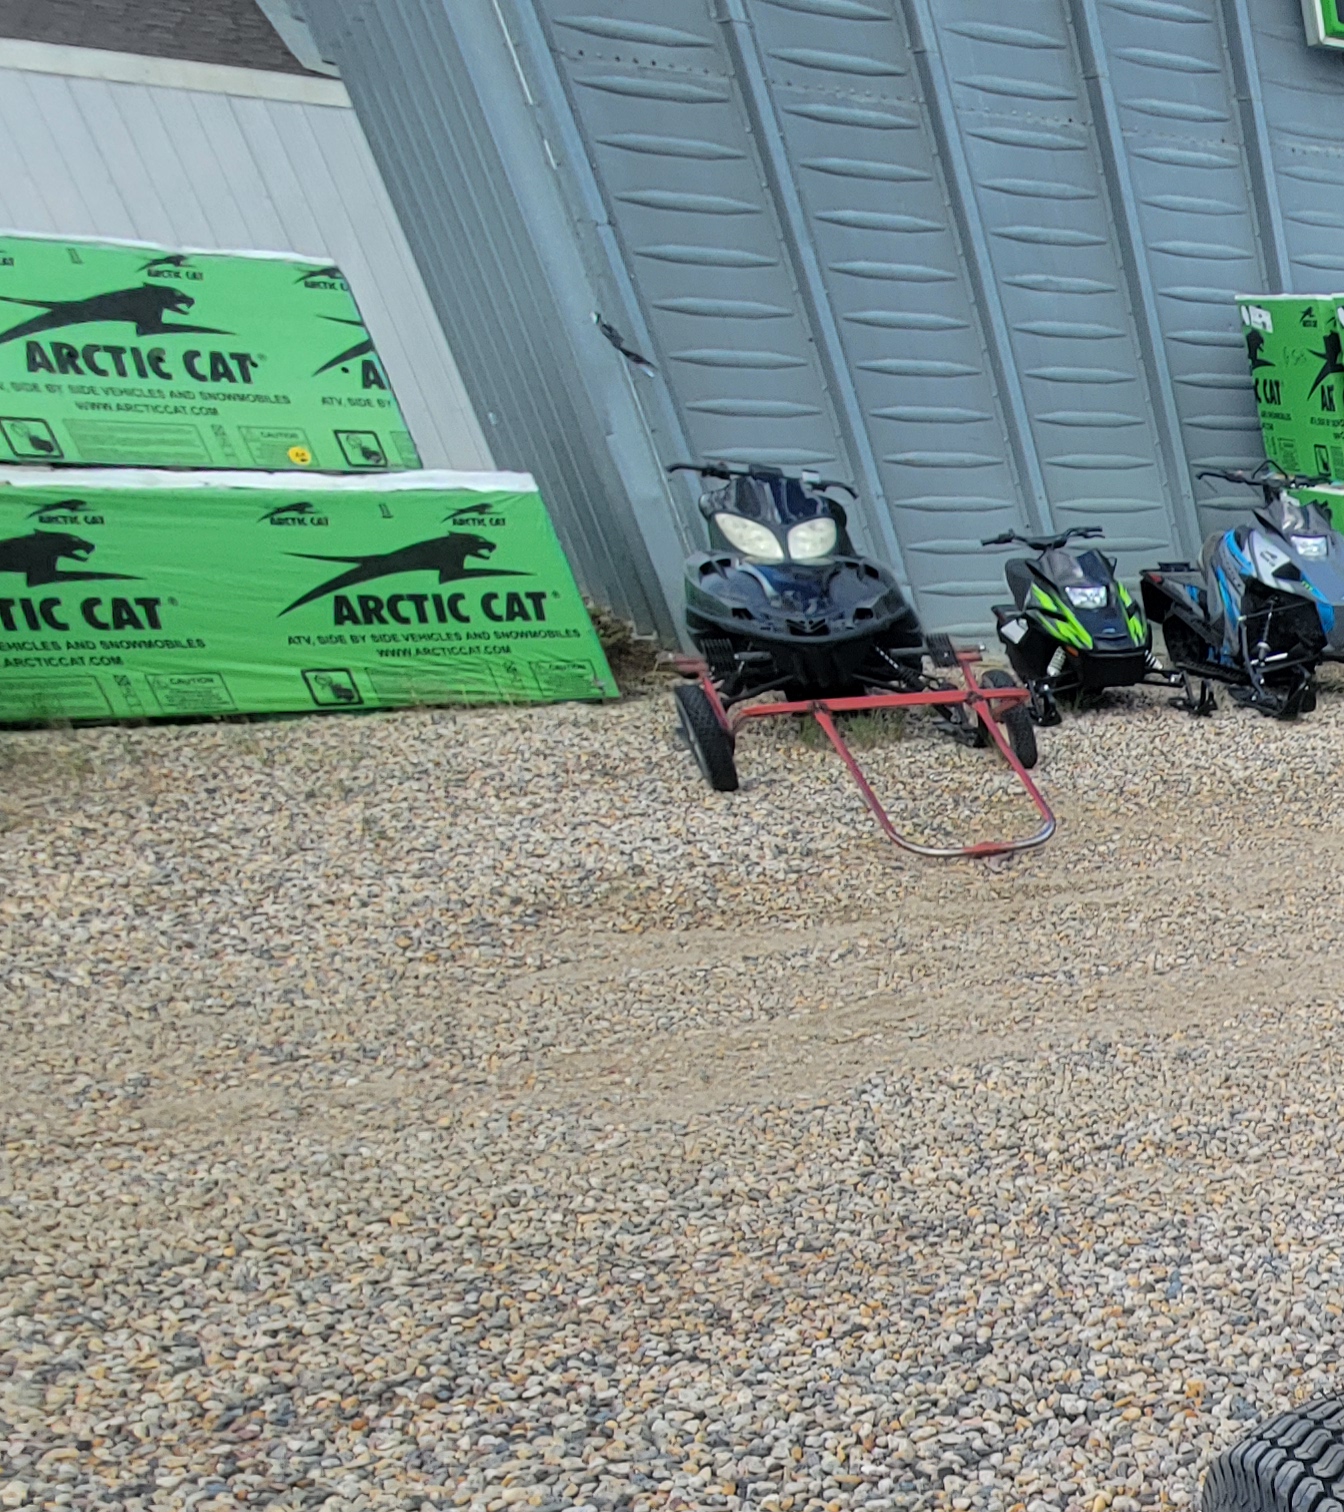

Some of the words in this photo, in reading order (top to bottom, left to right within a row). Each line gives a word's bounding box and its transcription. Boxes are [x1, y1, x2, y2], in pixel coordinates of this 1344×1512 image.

[26, 341, 173, 381] ARCTIC
[183, 349, 254, 384] CAT
[101, 386, 167, 399] VEHICLES
[169, 390, 196, 400] AND
[198, 391, 291, 405] SNOWMOBILES
[75, 401, 219, 416] WWW.ARCTICCAT.COM
[81, 597, 162, 631] CAT
[333, 594, 471, 626] ARCTIC
[480, 591, 547, 623] CAT
[66, 640, 96, 651] AND
[102, 638, 206, 650] SNOWMOBILES
[287, 635, 315, 646] ATV,
[318, 634, 347, 645] SIDE
[350, 633, 368, 644] BY
[371, 632, 401, 643] SIDE
[402, 631, 463, 643] VEHICLES
[466, 631, 491, 641] AND
[494, 628, 581, 640] SNOWMOBILES
[376, 645, 512, 658] WWW.ARCTICCAT.COM
